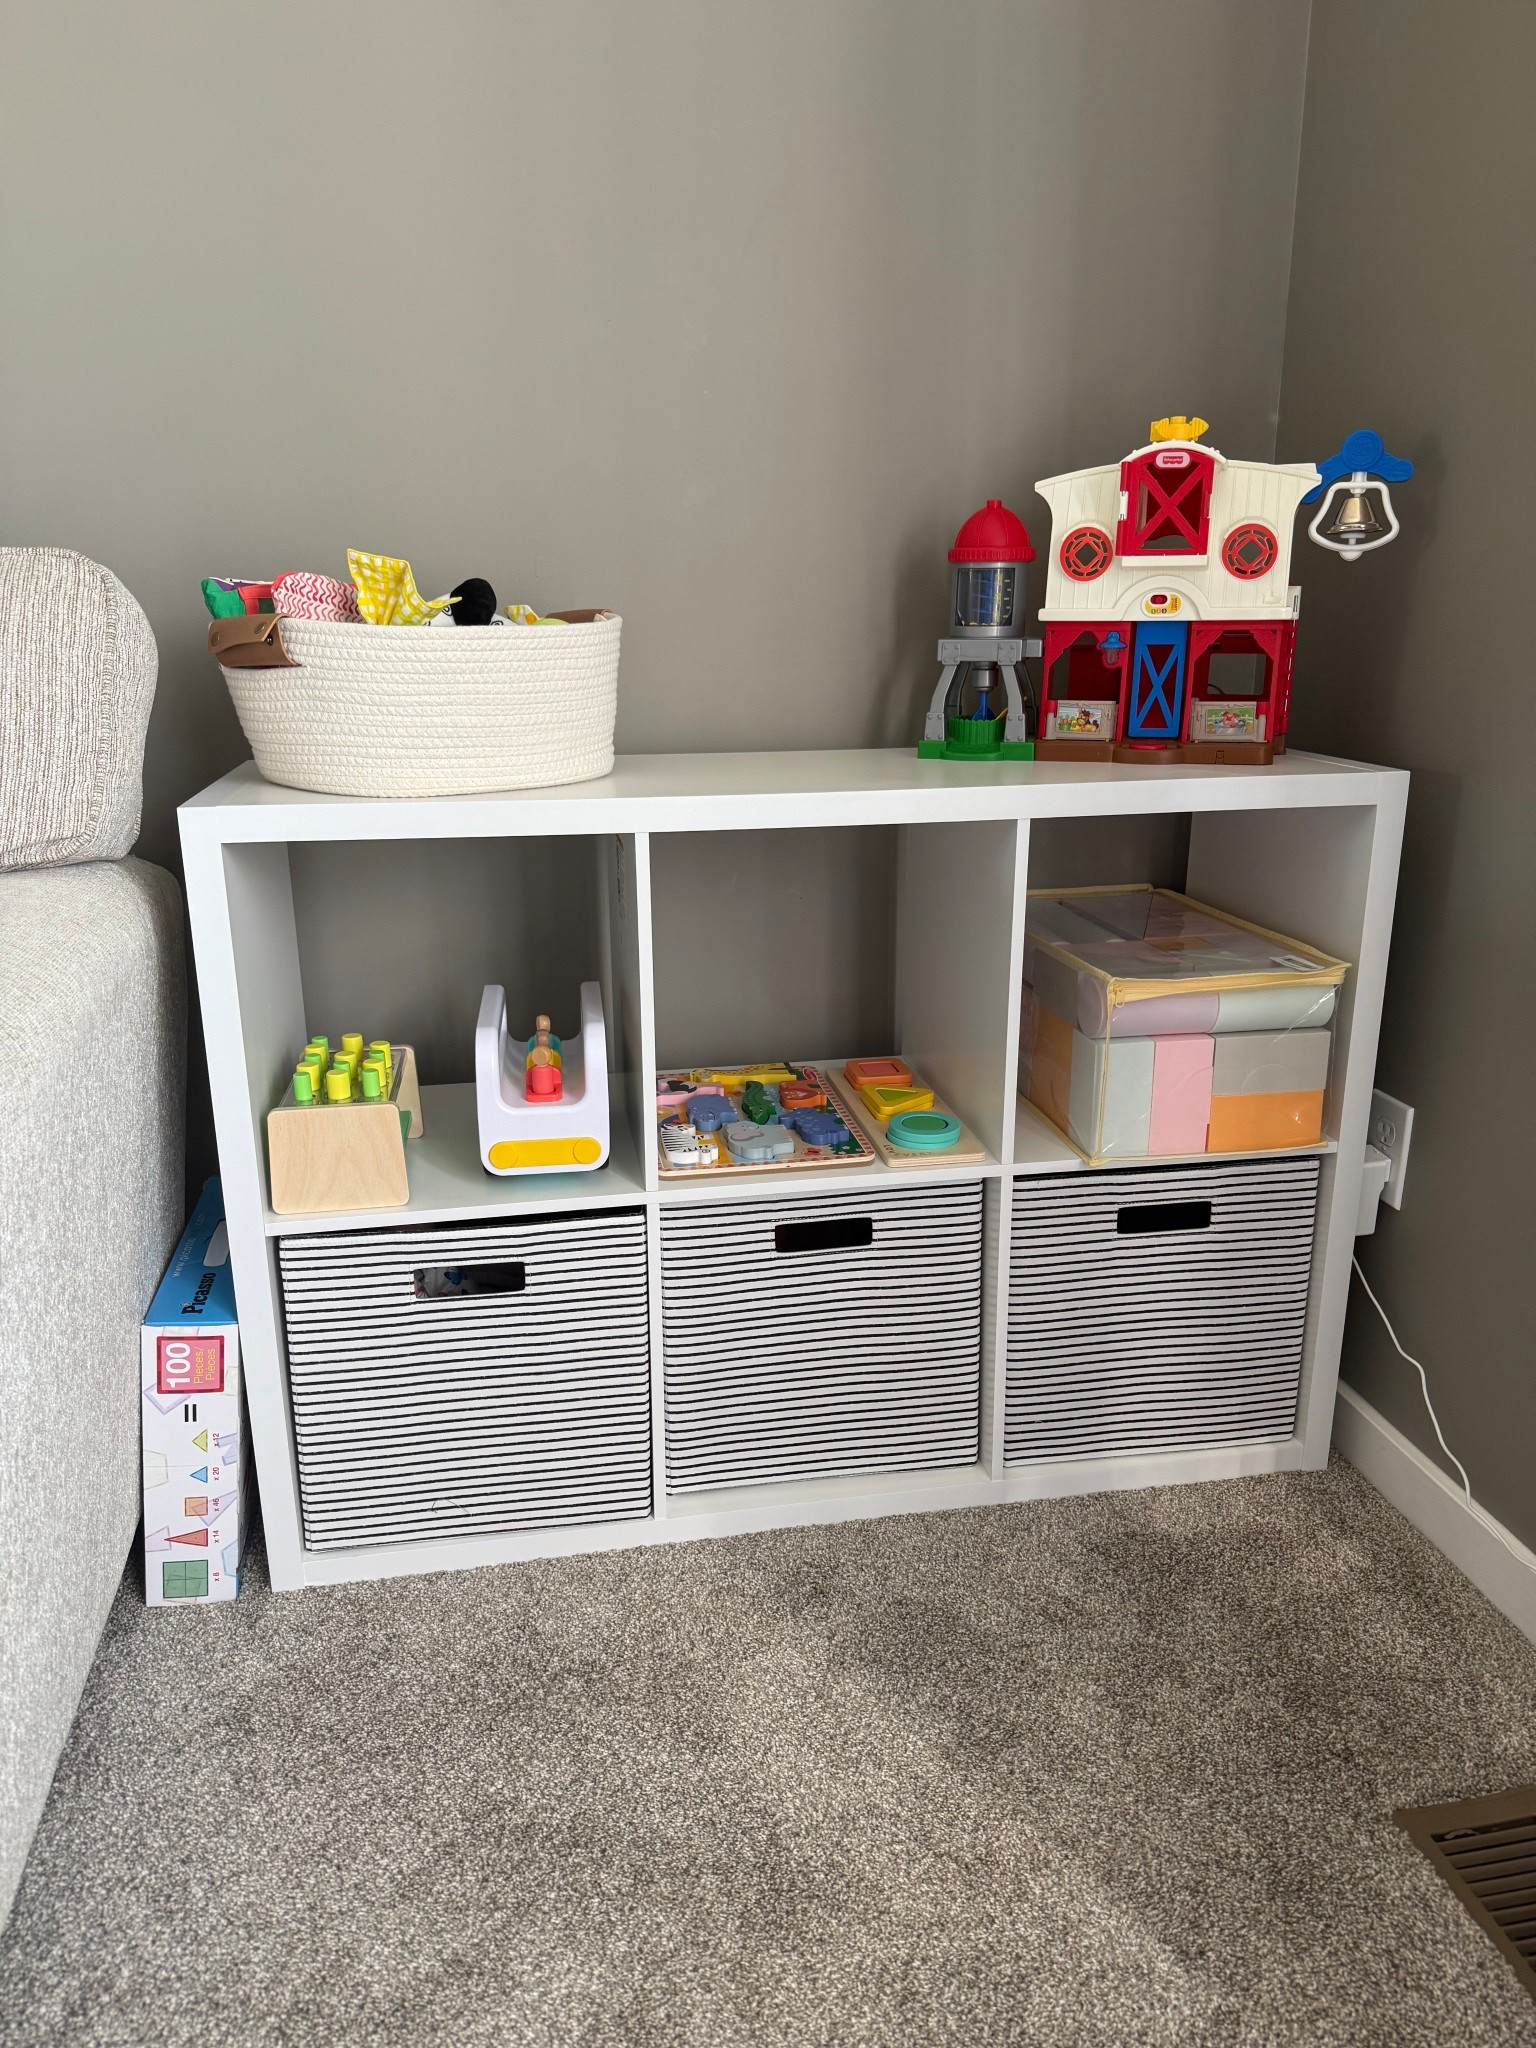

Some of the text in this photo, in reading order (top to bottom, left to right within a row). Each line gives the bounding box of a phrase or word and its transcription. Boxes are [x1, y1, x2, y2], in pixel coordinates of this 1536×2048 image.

[181, 1272, 217, 1314] Picasso
[165, 1342, 191, 1388] 100
[193, 1346, 204, 1384] Pieces/
